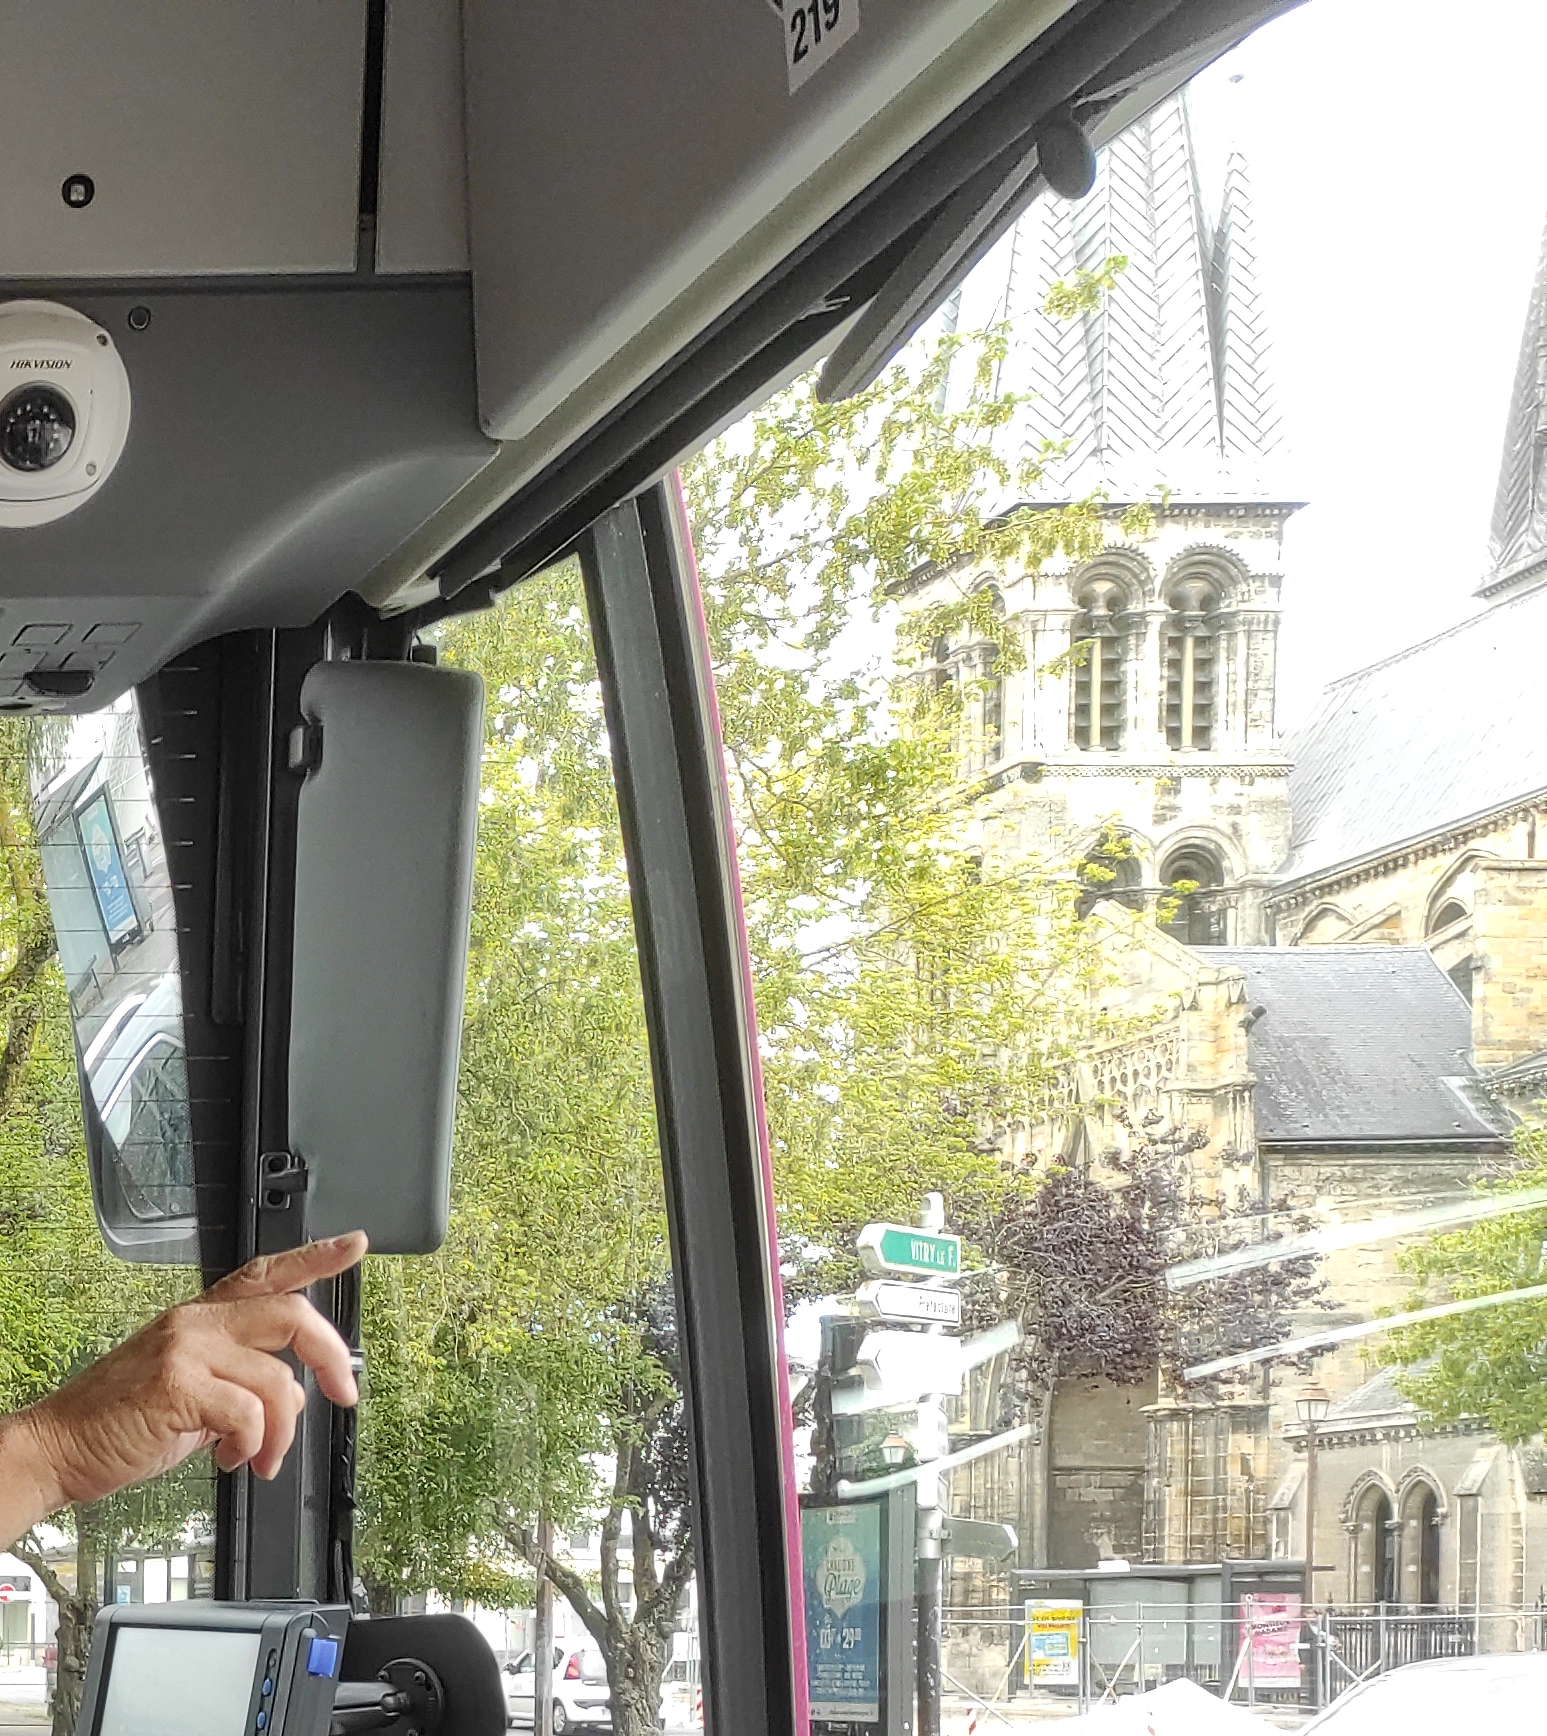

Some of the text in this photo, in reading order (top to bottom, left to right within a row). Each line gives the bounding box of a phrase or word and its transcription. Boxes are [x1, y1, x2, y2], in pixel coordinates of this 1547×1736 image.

[790, 0, 840, 64] 219
[10, 359, 73, 370] HIKVISION
[911, 1239, 935, 1263] VITRY
